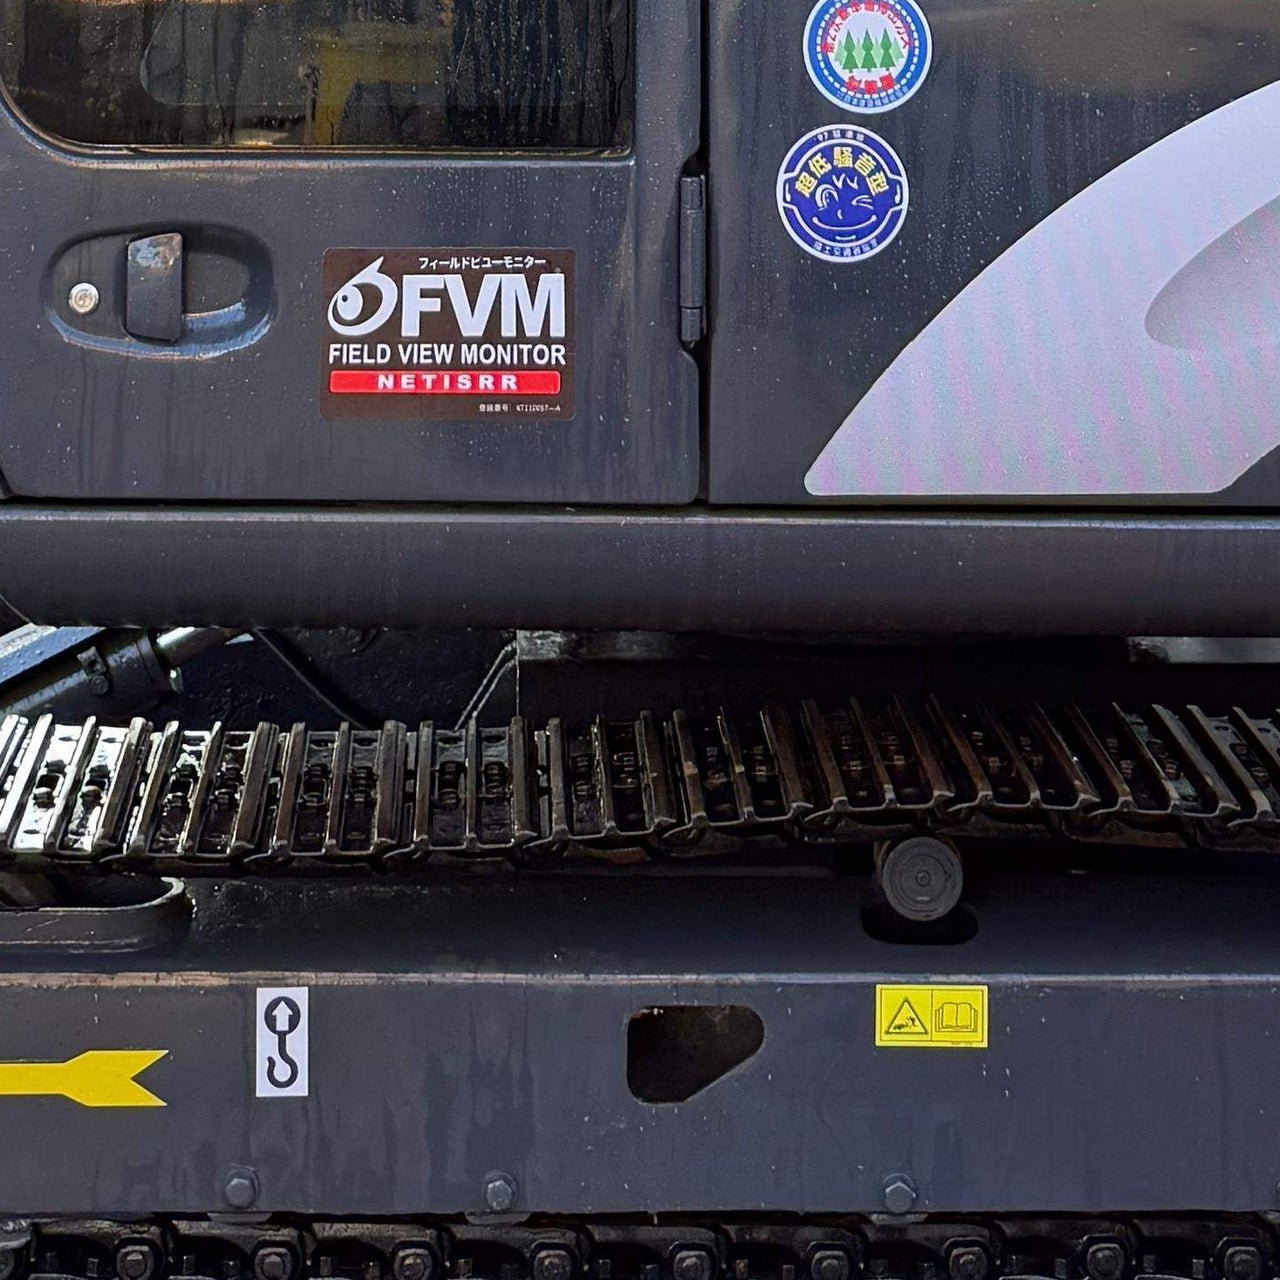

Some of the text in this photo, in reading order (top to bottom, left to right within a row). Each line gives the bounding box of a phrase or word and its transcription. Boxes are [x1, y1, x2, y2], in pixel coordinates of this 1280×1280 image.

[401, 273, 566, 338] FVM
[328, 343, 567, 366] FIELD VIEW MONITOR
